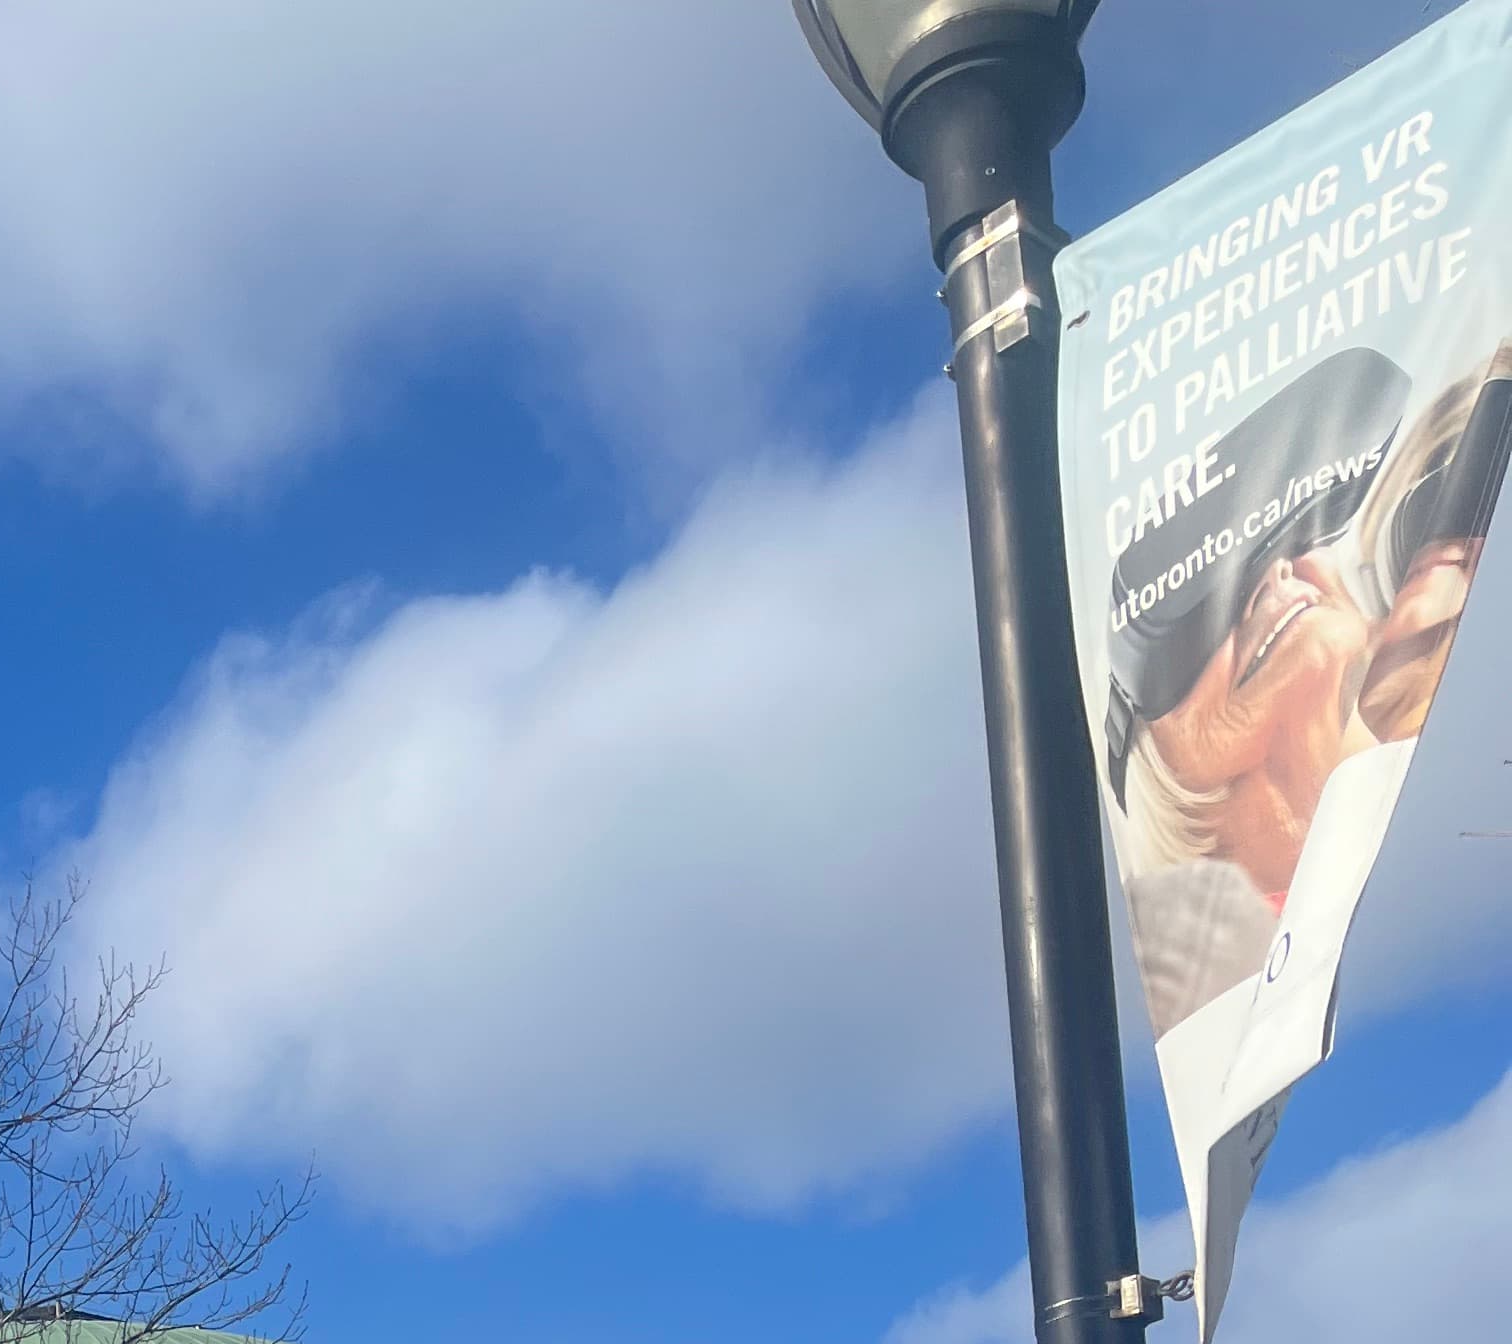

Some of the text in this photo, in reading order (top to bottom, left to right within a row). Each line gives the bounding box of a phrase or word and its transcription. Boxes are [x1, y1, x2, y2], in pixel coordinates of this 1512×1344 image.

[1102, 160, 1449, 412] EXPERIENCES
[1107, 111, 1433, 344] BRINGING VR
[1101, 227, 1472, 482] TO PALLIATIVE
[1105, 430, 1236, 561] CARE.
[1110, 443, 1383, 633] utoronto.ca/news
